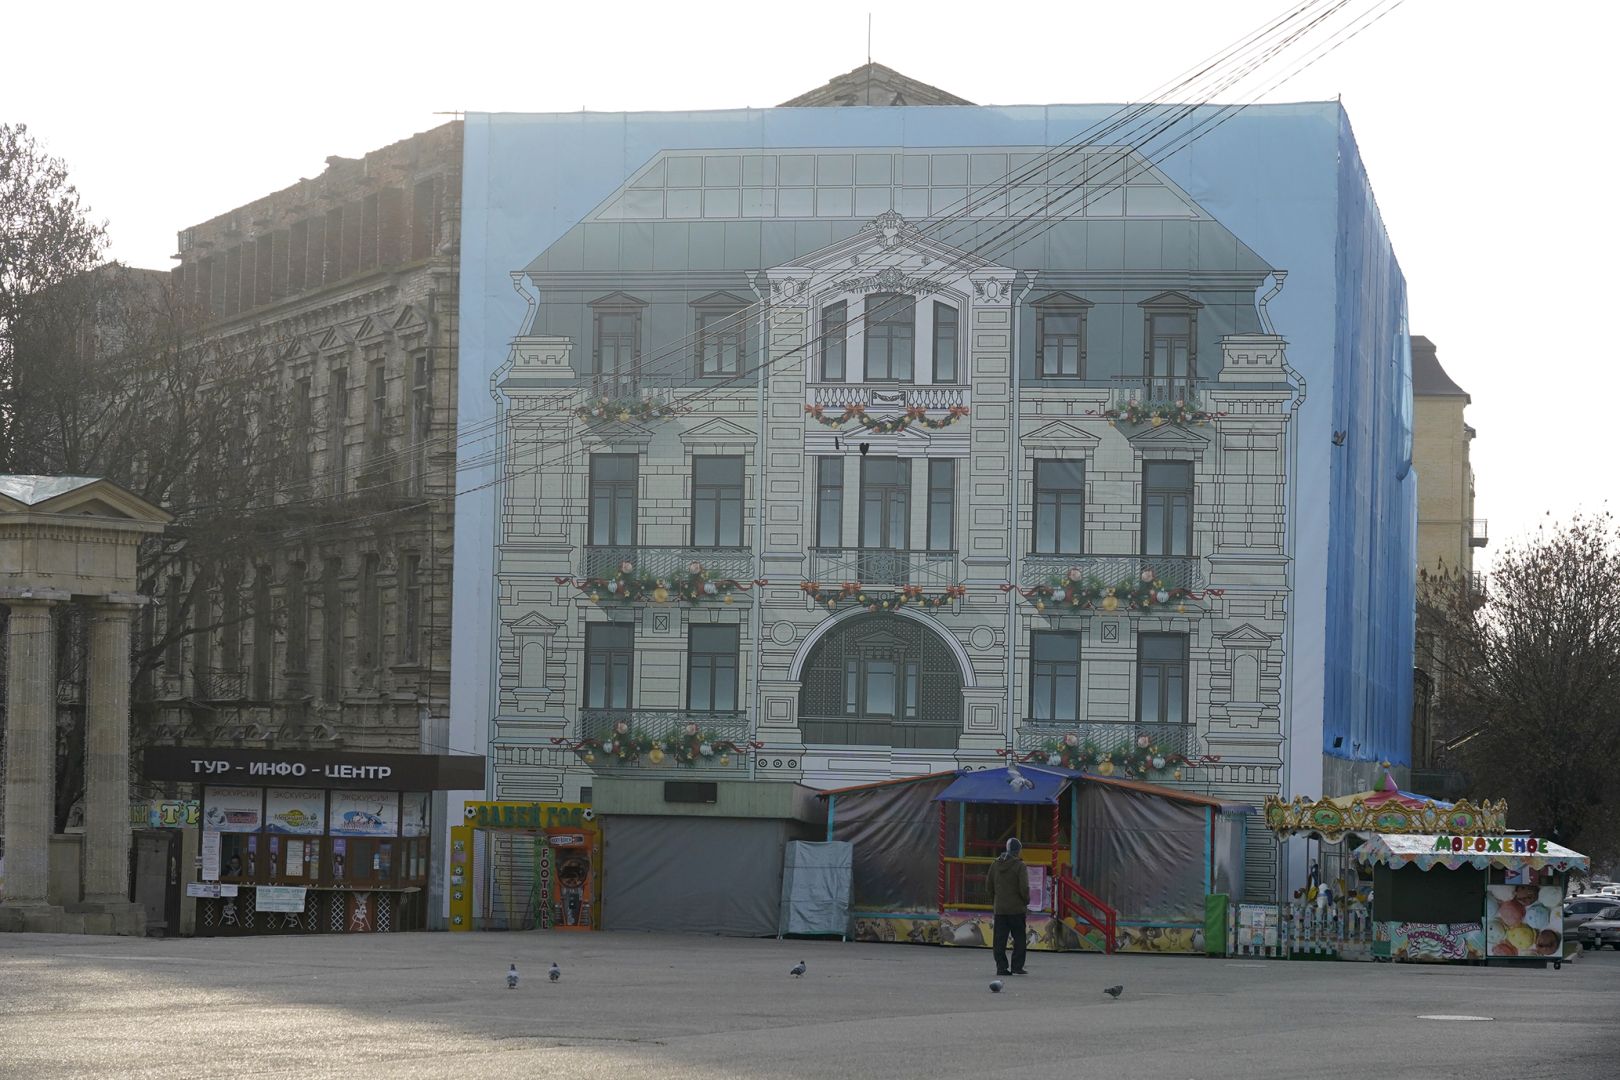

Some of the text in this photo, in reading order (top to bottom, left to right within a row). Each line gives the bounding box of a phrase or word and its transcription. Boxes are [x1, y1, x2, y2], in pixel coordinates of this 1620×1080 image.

[191, 760, 230, 774] ТУР
[249, 762, 306, 776] ИНФО
[325, 764, 392, 780] ЦЕНТР
[1435, 835, 1549, 853] МОРОЖЕНОЕ
[541, 848, 549, 930] FOOTBALL
